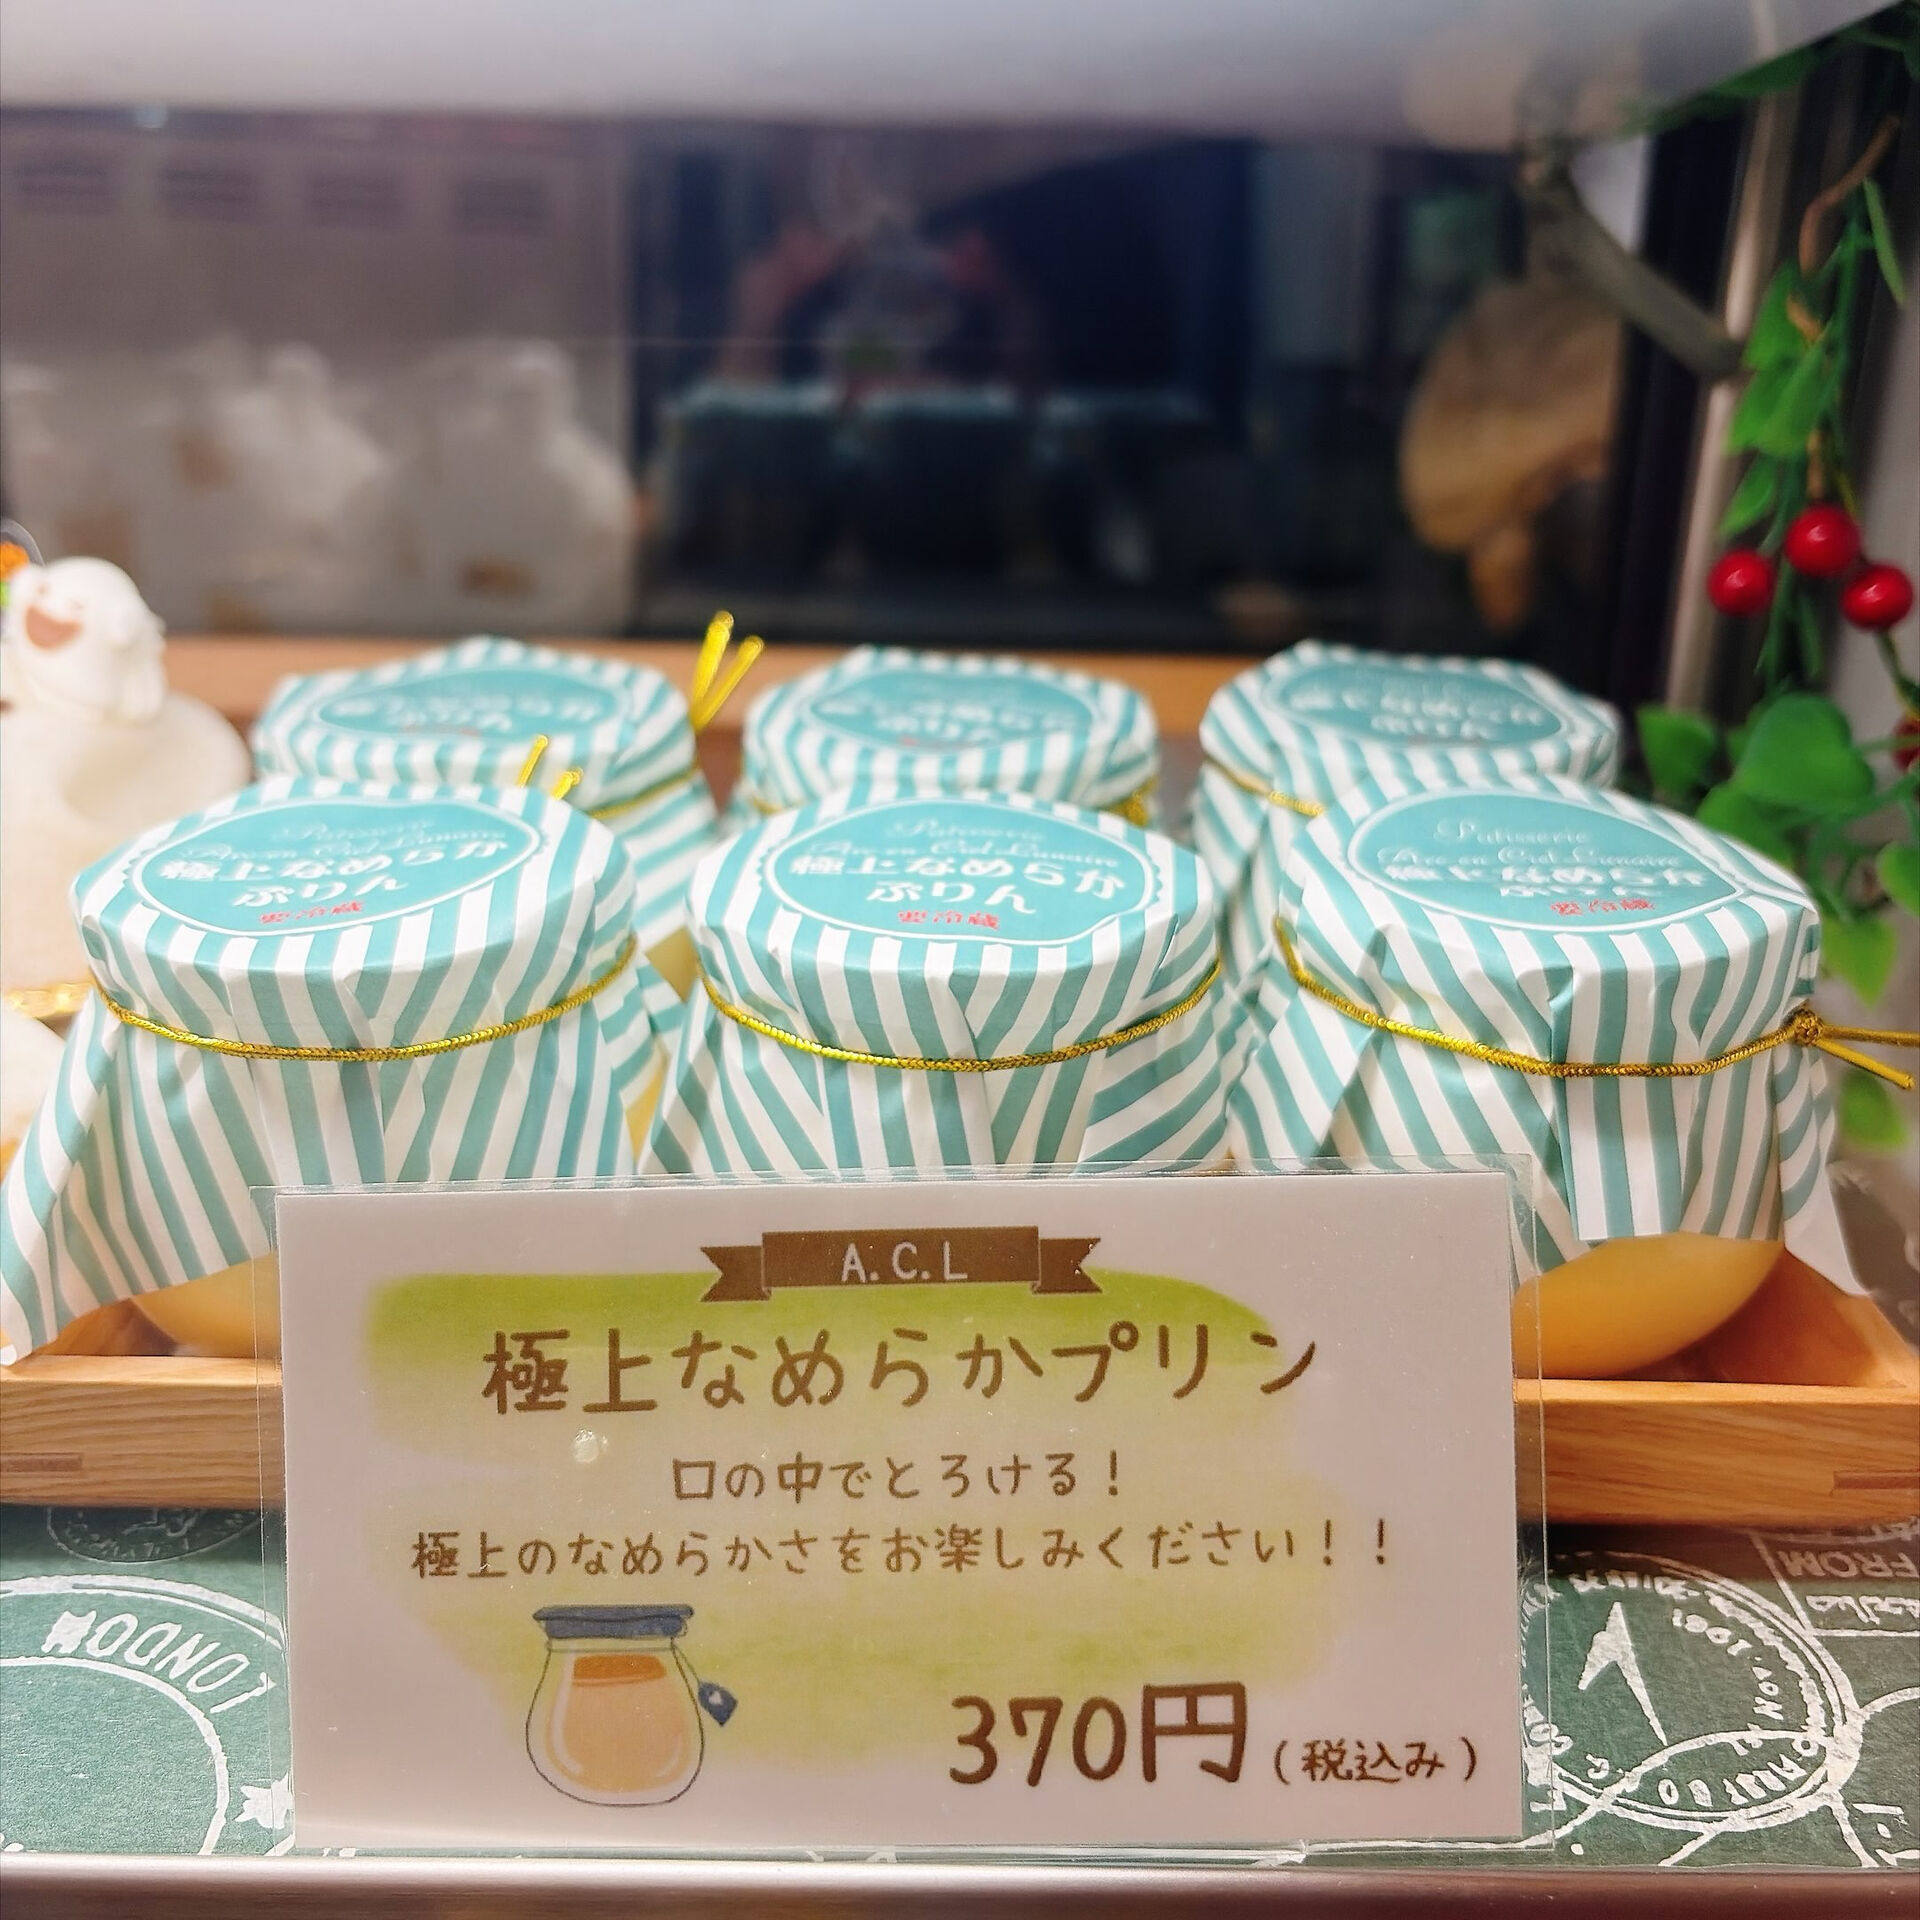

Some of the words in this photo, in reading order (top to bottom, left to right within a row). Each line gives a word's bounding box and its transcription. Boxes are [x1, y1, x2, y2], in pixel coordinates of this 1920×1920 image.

[231, 874, 408, 908] ぷりん
[788, 856, 1126, 900] 極上なめらか
[866, 880, 1037, 916] ぷりん
[483, 1321, 1315, 1414] 極上なめらかプリン
[673, 1452, 1117, 1502] 口の中でとろける！
[412, 1520, 1384, 1578] 極上のなめらかさをお楽しみください！！
[950, 1683, 1246, 1787] 370円
